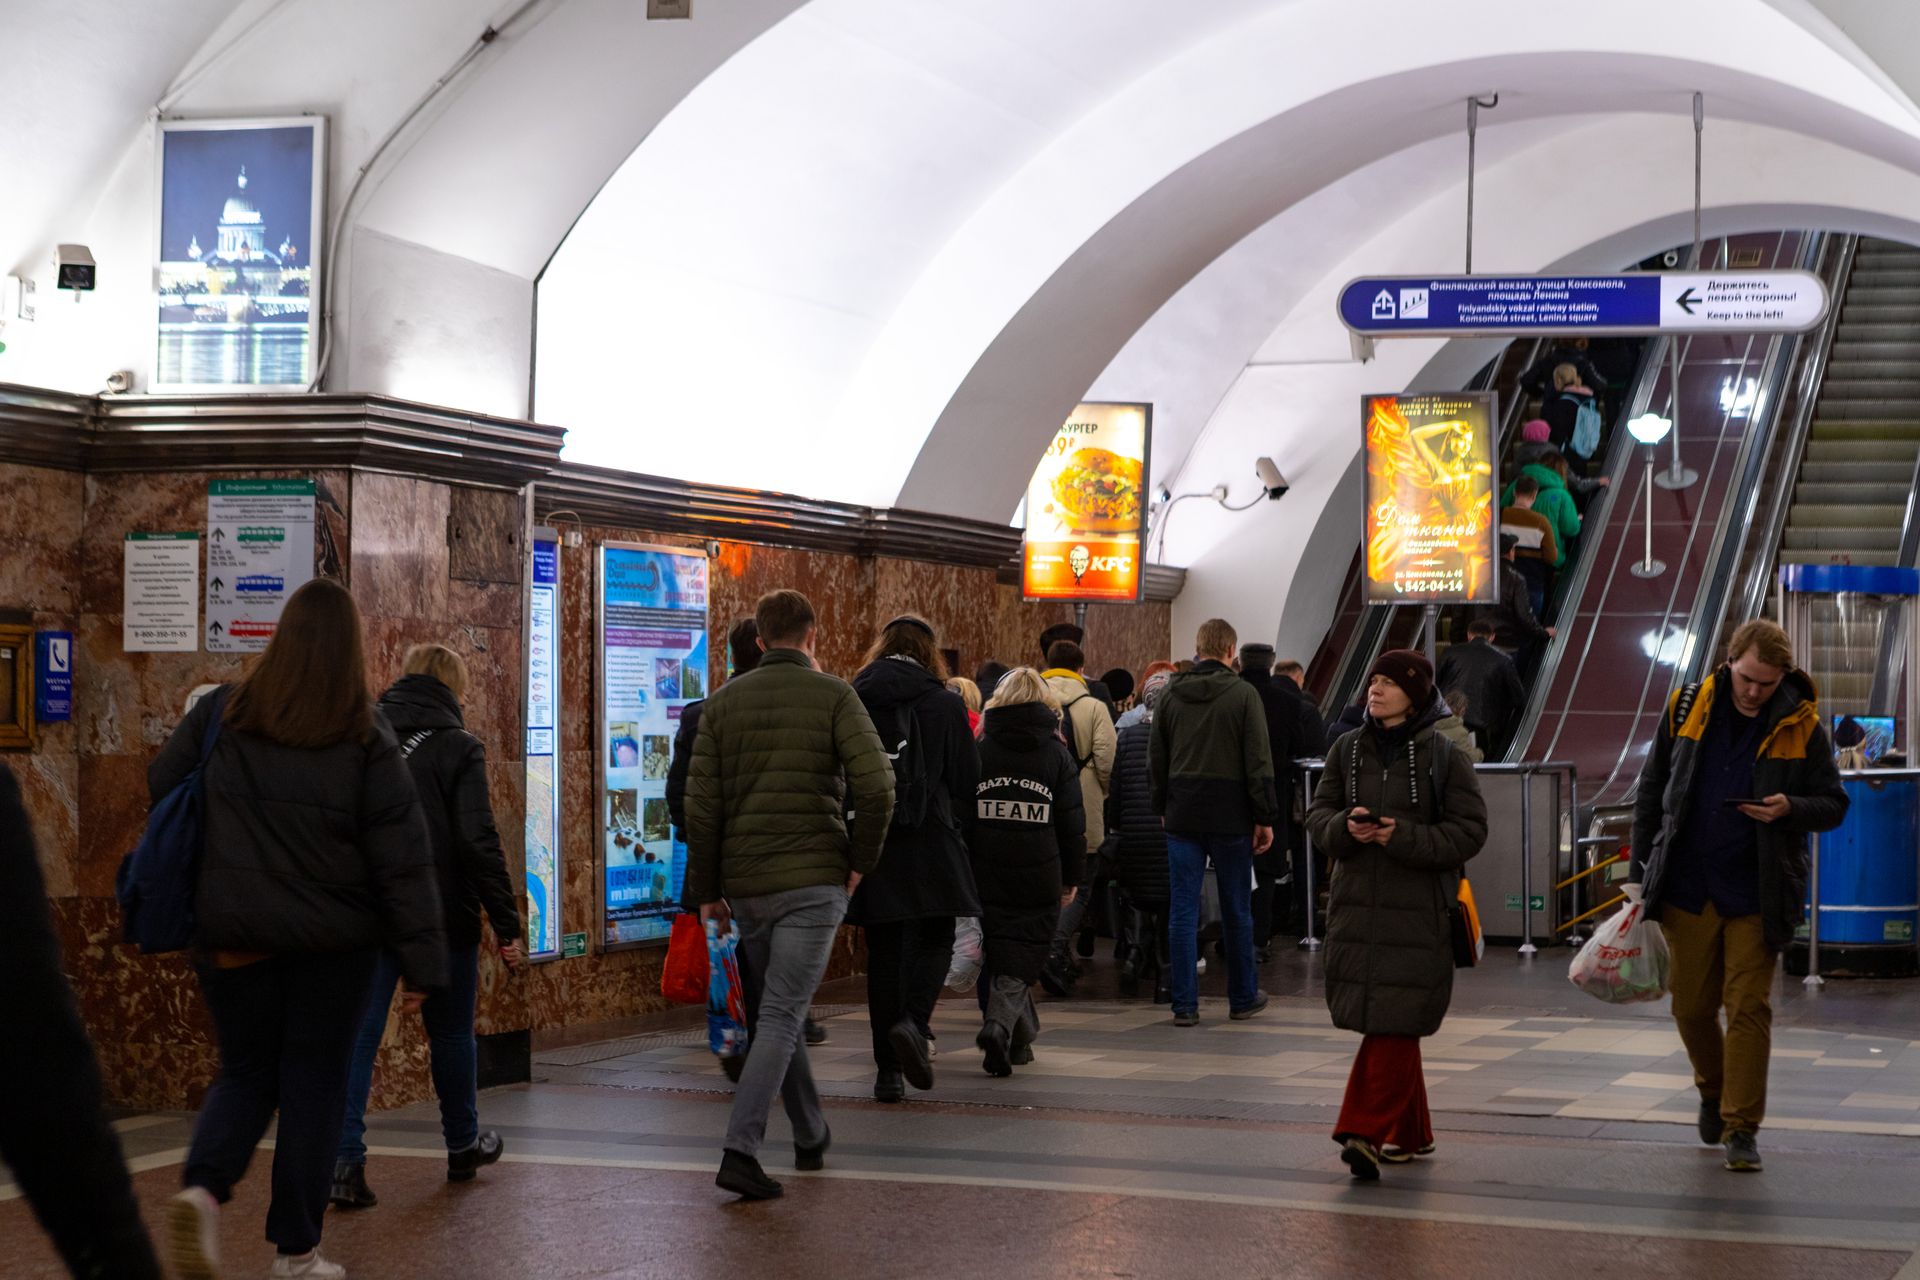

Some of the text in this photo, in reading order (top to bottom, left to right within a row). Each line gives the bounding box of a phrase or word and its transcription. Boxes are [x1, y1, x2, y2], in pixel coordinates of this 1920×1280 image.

[1430, 279, 1626, 292] Финляндский вокзал, улица Комсомола,
[1707, 280, 1769, 291] Держитесь
[1488, 290, 1569, 302] площадь Ленина
[1708, 291, 1797, 303] левой стороны!
[1458, 303, 1599, 315] Finlyandskiy vokzal railway station,
[1707, 310, 1783, 320] Keep to the left!
[1460, 313, 1597, 324] Komsomola street, Lenina square
[1089, 556, 1132, 573] KFC
[1405, 579, 1464, 592] 542-04-14
[983, 801, 1044, 821] TEAM
